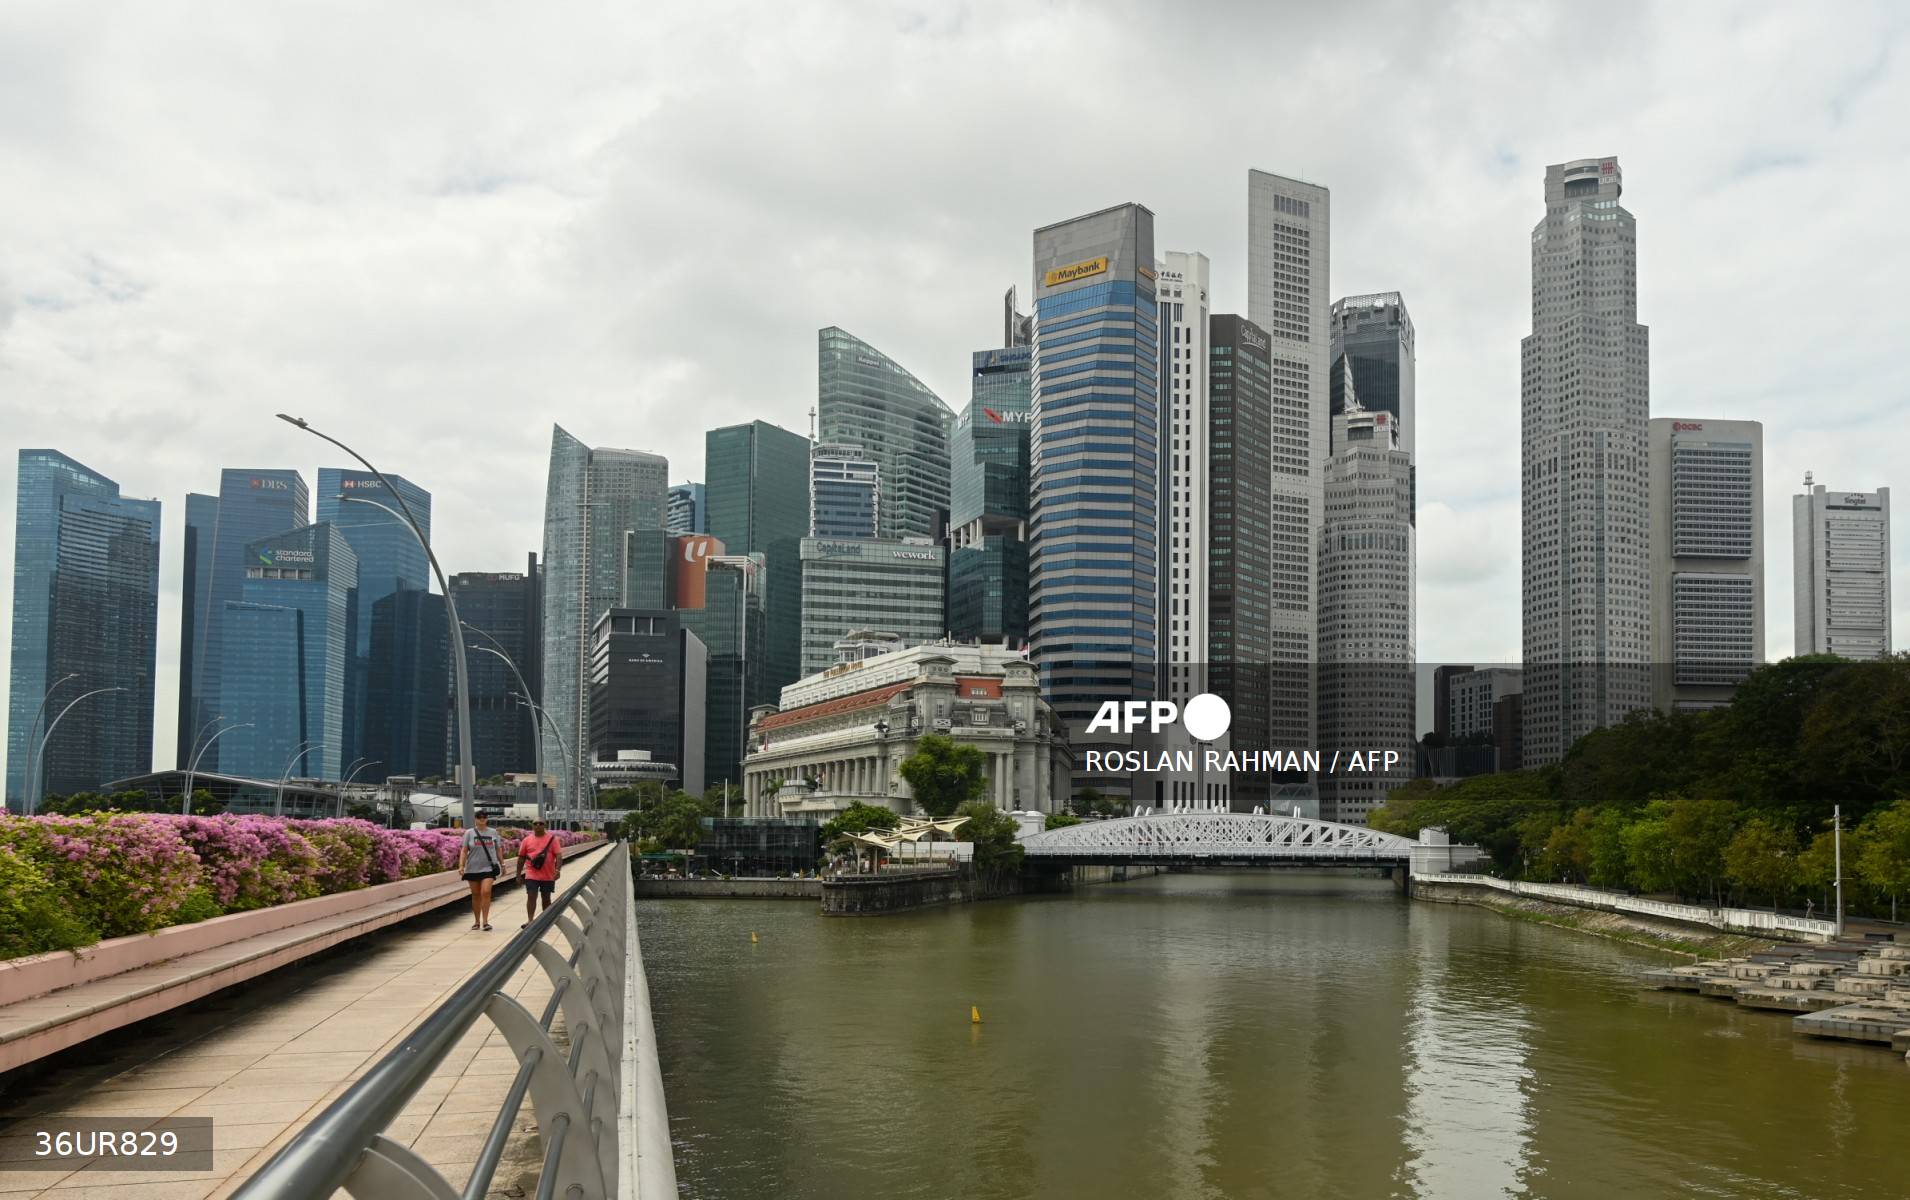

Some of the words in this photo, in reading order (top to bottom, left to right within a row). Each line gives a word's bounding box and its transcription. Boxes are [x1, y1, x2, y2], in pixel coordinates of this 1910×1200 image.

[1058, 261, 1100, 280] Maybank
[262, 480, 288, 489] DBS
[357, 480, 382, 488] HSBC
[816, 541, 862, 555] CapitaLand
[275, 554, 314, 563] chartered
[893, 549, 936, 560] wework
